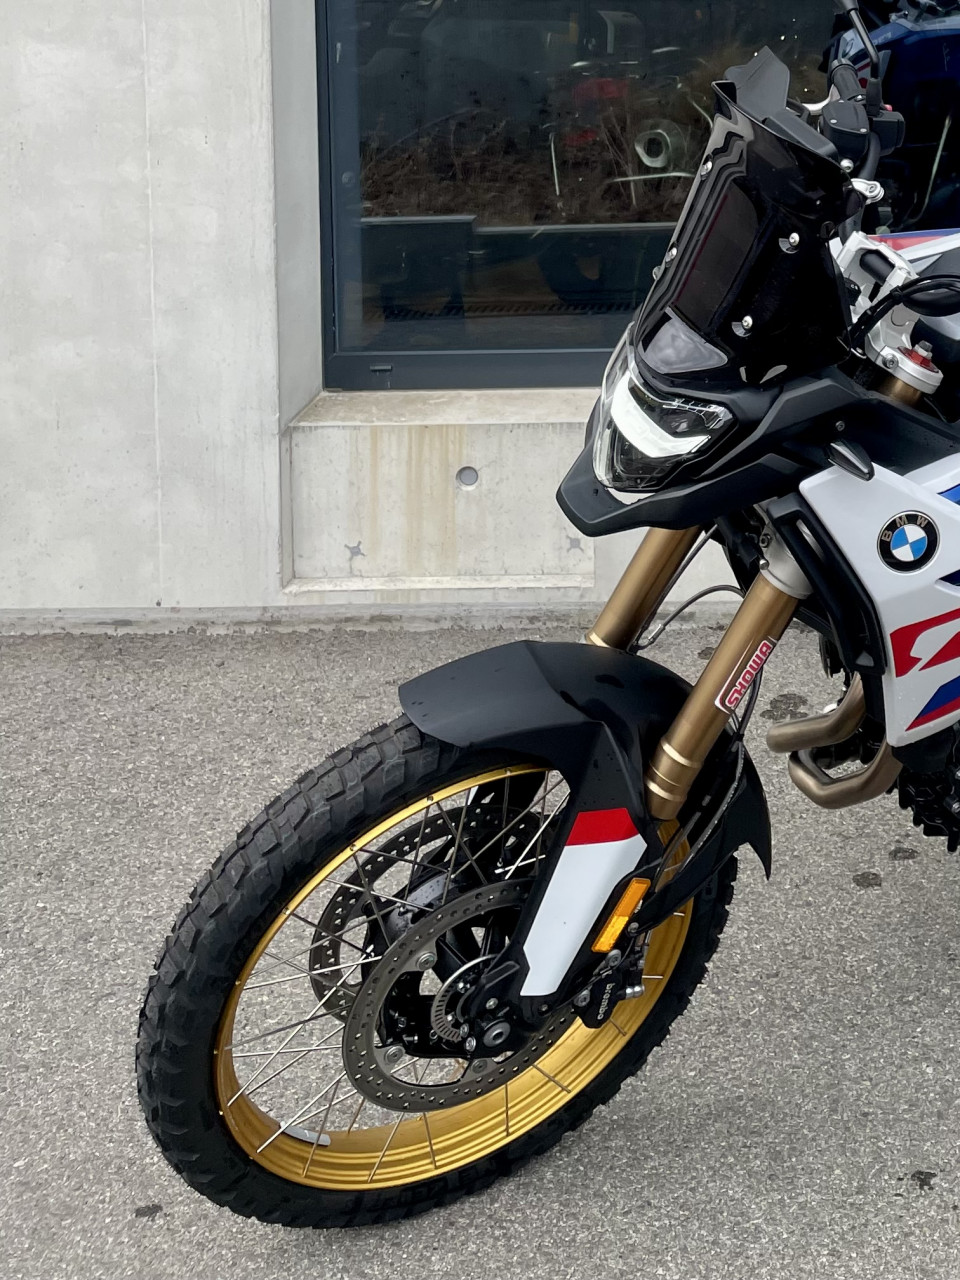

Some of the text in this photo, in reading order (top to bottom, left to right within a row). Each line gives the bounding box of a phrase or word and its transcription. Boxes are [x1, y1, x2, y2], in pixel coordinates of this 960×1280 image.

[881, 514, 929, 542] BMW
[726, 640, 773, 709] SHOWA
[597, 982, 616, 1020] brembo
